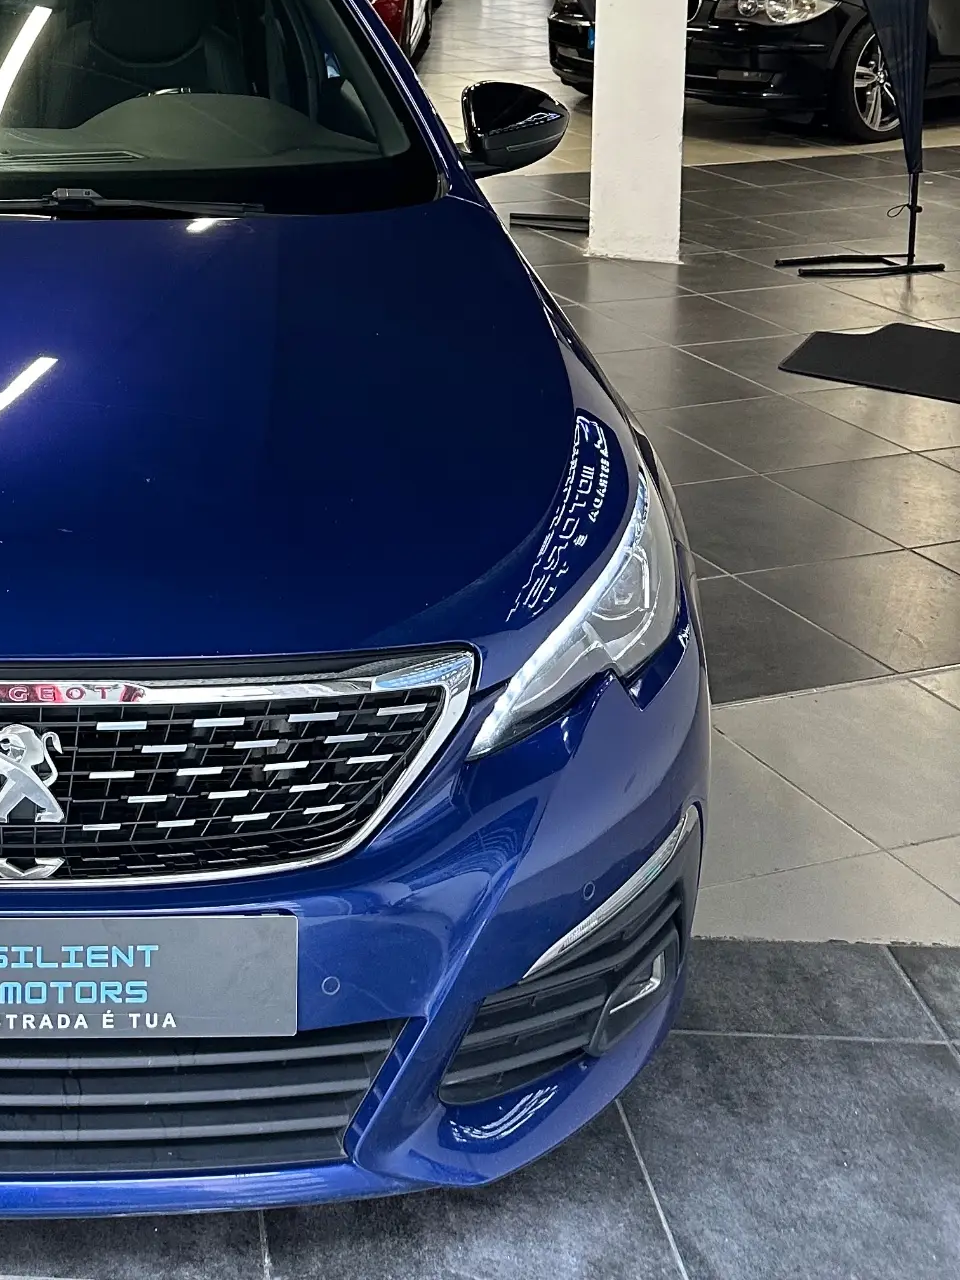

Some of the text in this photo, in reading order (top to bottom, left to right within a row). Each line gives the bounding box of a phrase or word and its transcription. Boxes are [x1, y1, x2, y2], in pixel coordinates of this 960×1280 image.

[0, 981, 148, 1004] MOTORS
[102, 1010, 115, 1029] É
[128, 1012, 177, 1029] TUA
